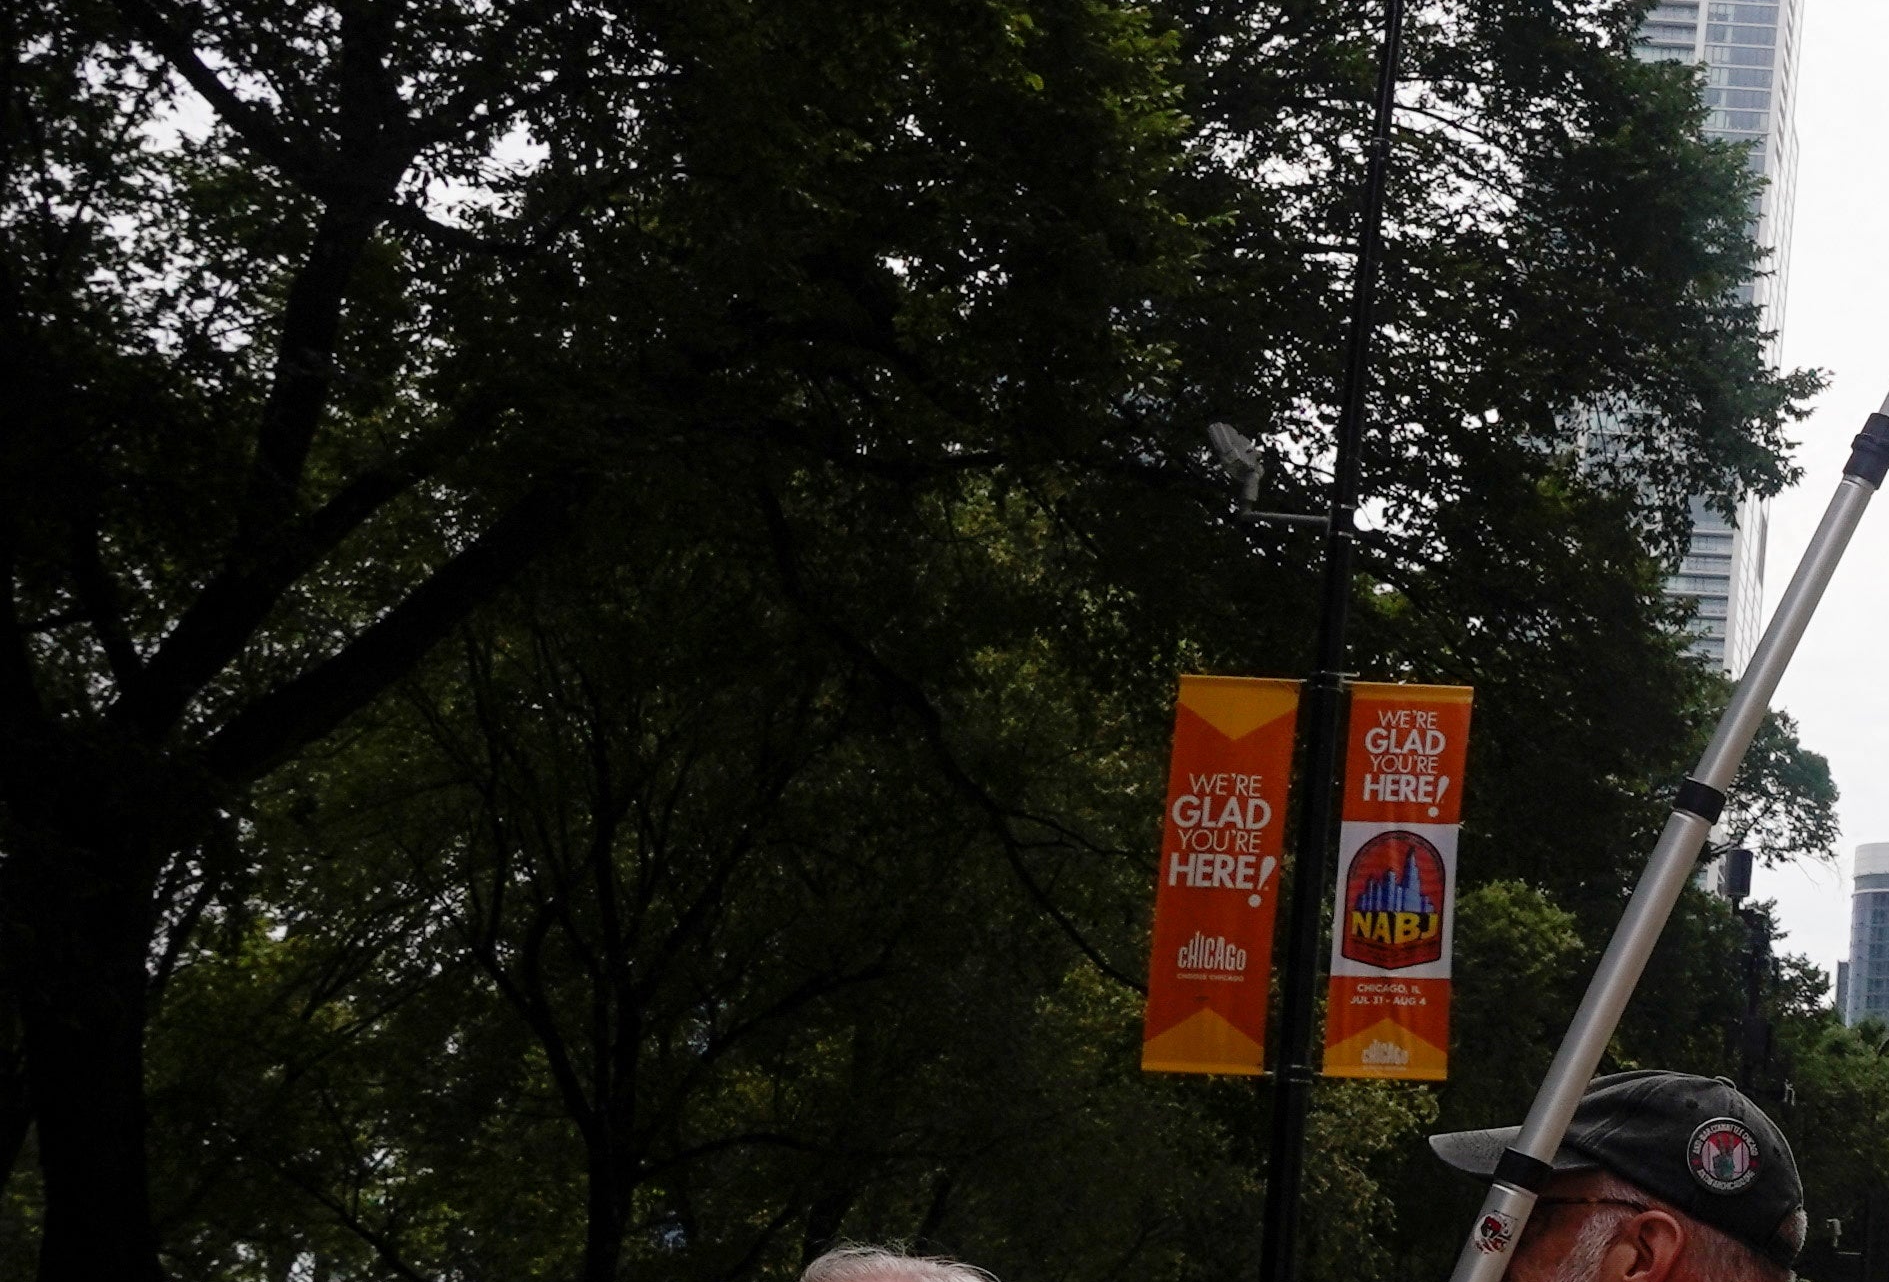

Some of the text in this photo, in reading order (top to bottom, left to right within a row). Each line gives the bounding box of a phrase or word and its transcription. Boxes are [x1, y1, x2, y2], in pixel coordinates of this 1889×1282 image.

[1378, 710, 1438, 729] WE'RE
[1365, 727, 1446, 755] GLAD
[1370, 754, 1439, 774] YOU'RE
[1189, 773, 1263, 797] WE'RE
[1363, 774, 1450, 817] HERE!
[1172, 795, 1272, 830] GLAD
[1178, 829, 1262, 853] YOU'RE
[1168, 852, 1277, 908] HERE!
[1352, 911, 1439, 945] NABJ
[1177, 931, 1247, 971] CHICAGO
[1350, 997, 1370, 1005] JUL
[1393, 997, 1416, 1006] AUG
[1419, 997, 1427, 1006] 4
[1357, 984, 1407, 994] CHICAGO,
